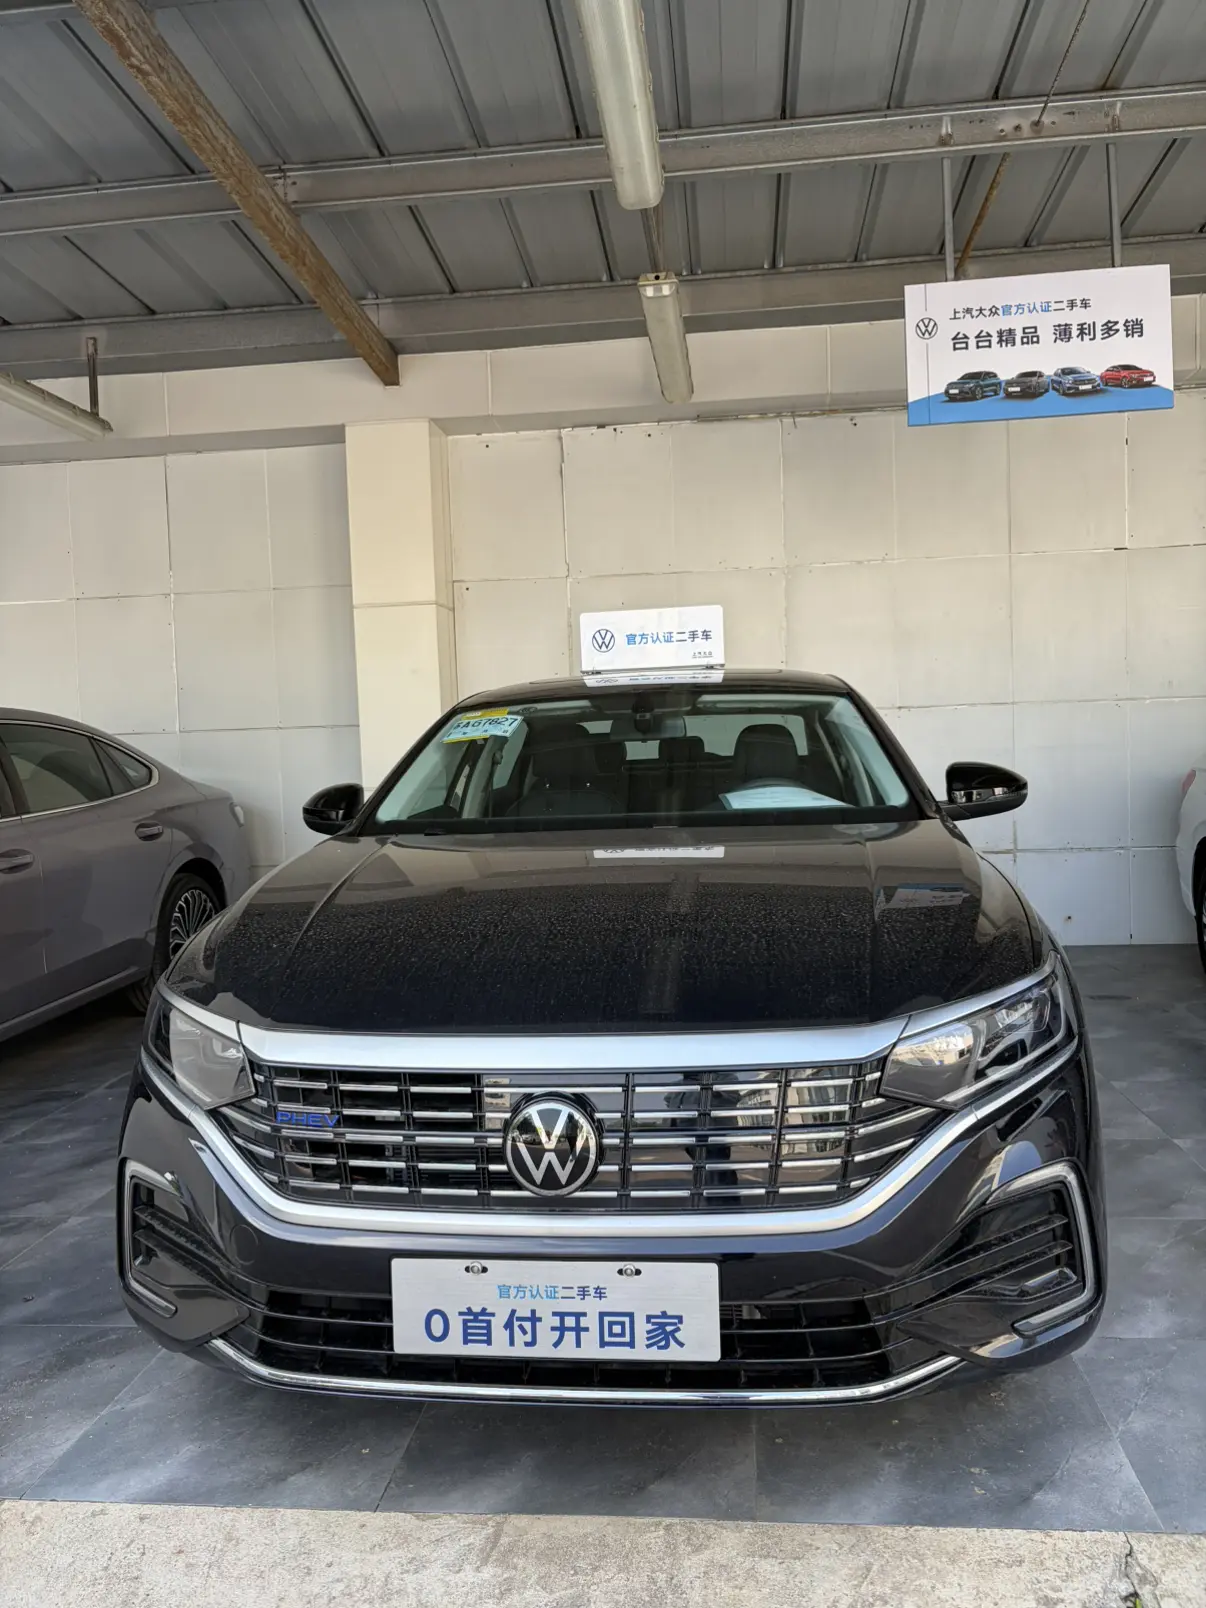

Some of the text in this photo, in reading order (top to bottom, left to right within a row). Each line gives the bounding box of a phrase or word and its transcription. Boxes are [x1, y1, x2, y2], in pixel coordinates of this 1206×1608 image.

[949, 298, 1092, 321] 上汽大众官方认证二手车
[950, 318, 1144, 352] 台台精品 薄利多销
[625, 629, 712, 646] 官方认证二手车
[275, 1112, 339, 1128] PHEV
[496, 1285, 608, 1301] 官方认证二手车
[424, 1307, 686, 1350] 0首付开回家
